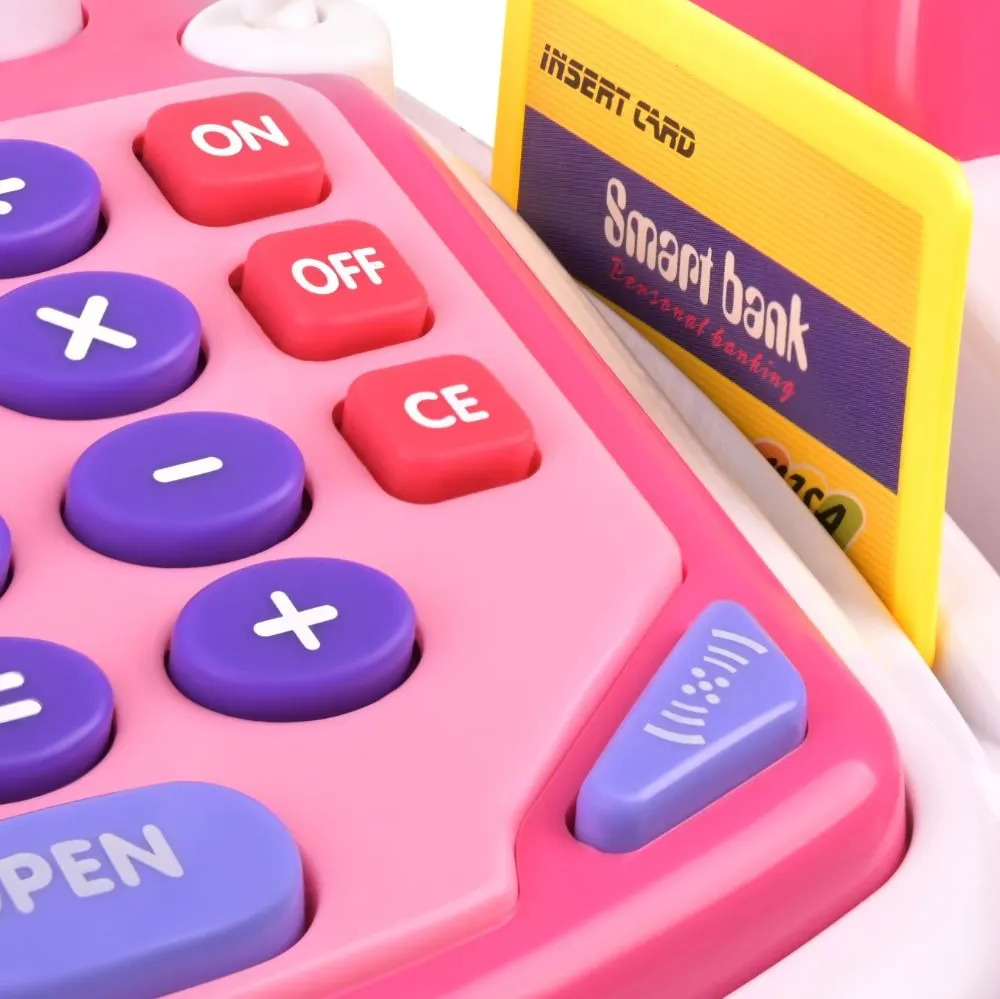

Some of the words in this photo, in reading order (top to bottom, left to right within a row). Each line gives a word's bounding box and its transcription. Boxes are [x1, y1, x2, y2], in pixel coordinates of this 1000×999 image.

[191, 115, 290, 157] ON
[540, 43, 631, 117] INSERT
[633, 100, 696, 159] CARD
[291, 247, 385, 295] OFF
[604, 177, 713, 306] Smart
[722, 250, 810, 372] bank
[610, 255, 710, 336] Personal
[710, 327, 797, 403] banking
[404, 384, 489, 429] CE
[0, 824, 184, 914] PEN
